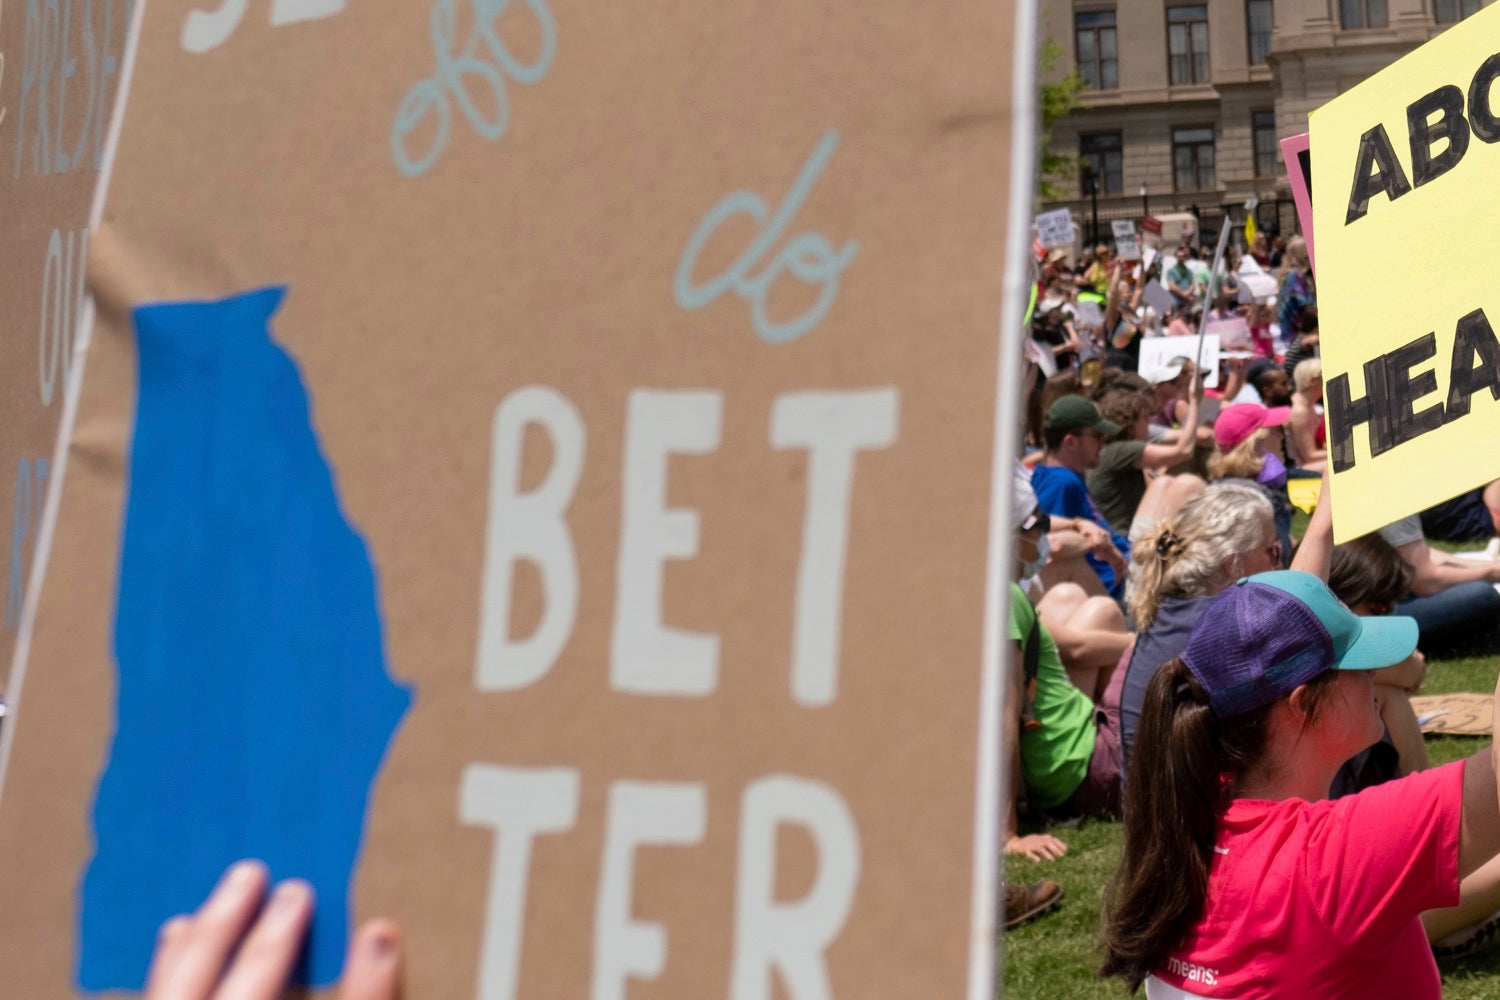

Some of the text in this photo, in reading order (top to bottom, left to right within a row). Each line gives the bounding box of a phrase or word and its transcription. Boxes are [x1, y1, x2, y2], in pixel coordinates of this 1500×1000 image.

[674, 129, 859, 345] do
[474, 385, 899, 708] BET
[458, 762, 862, 1000] TER
[1167, 956, 1220, 986] means:
